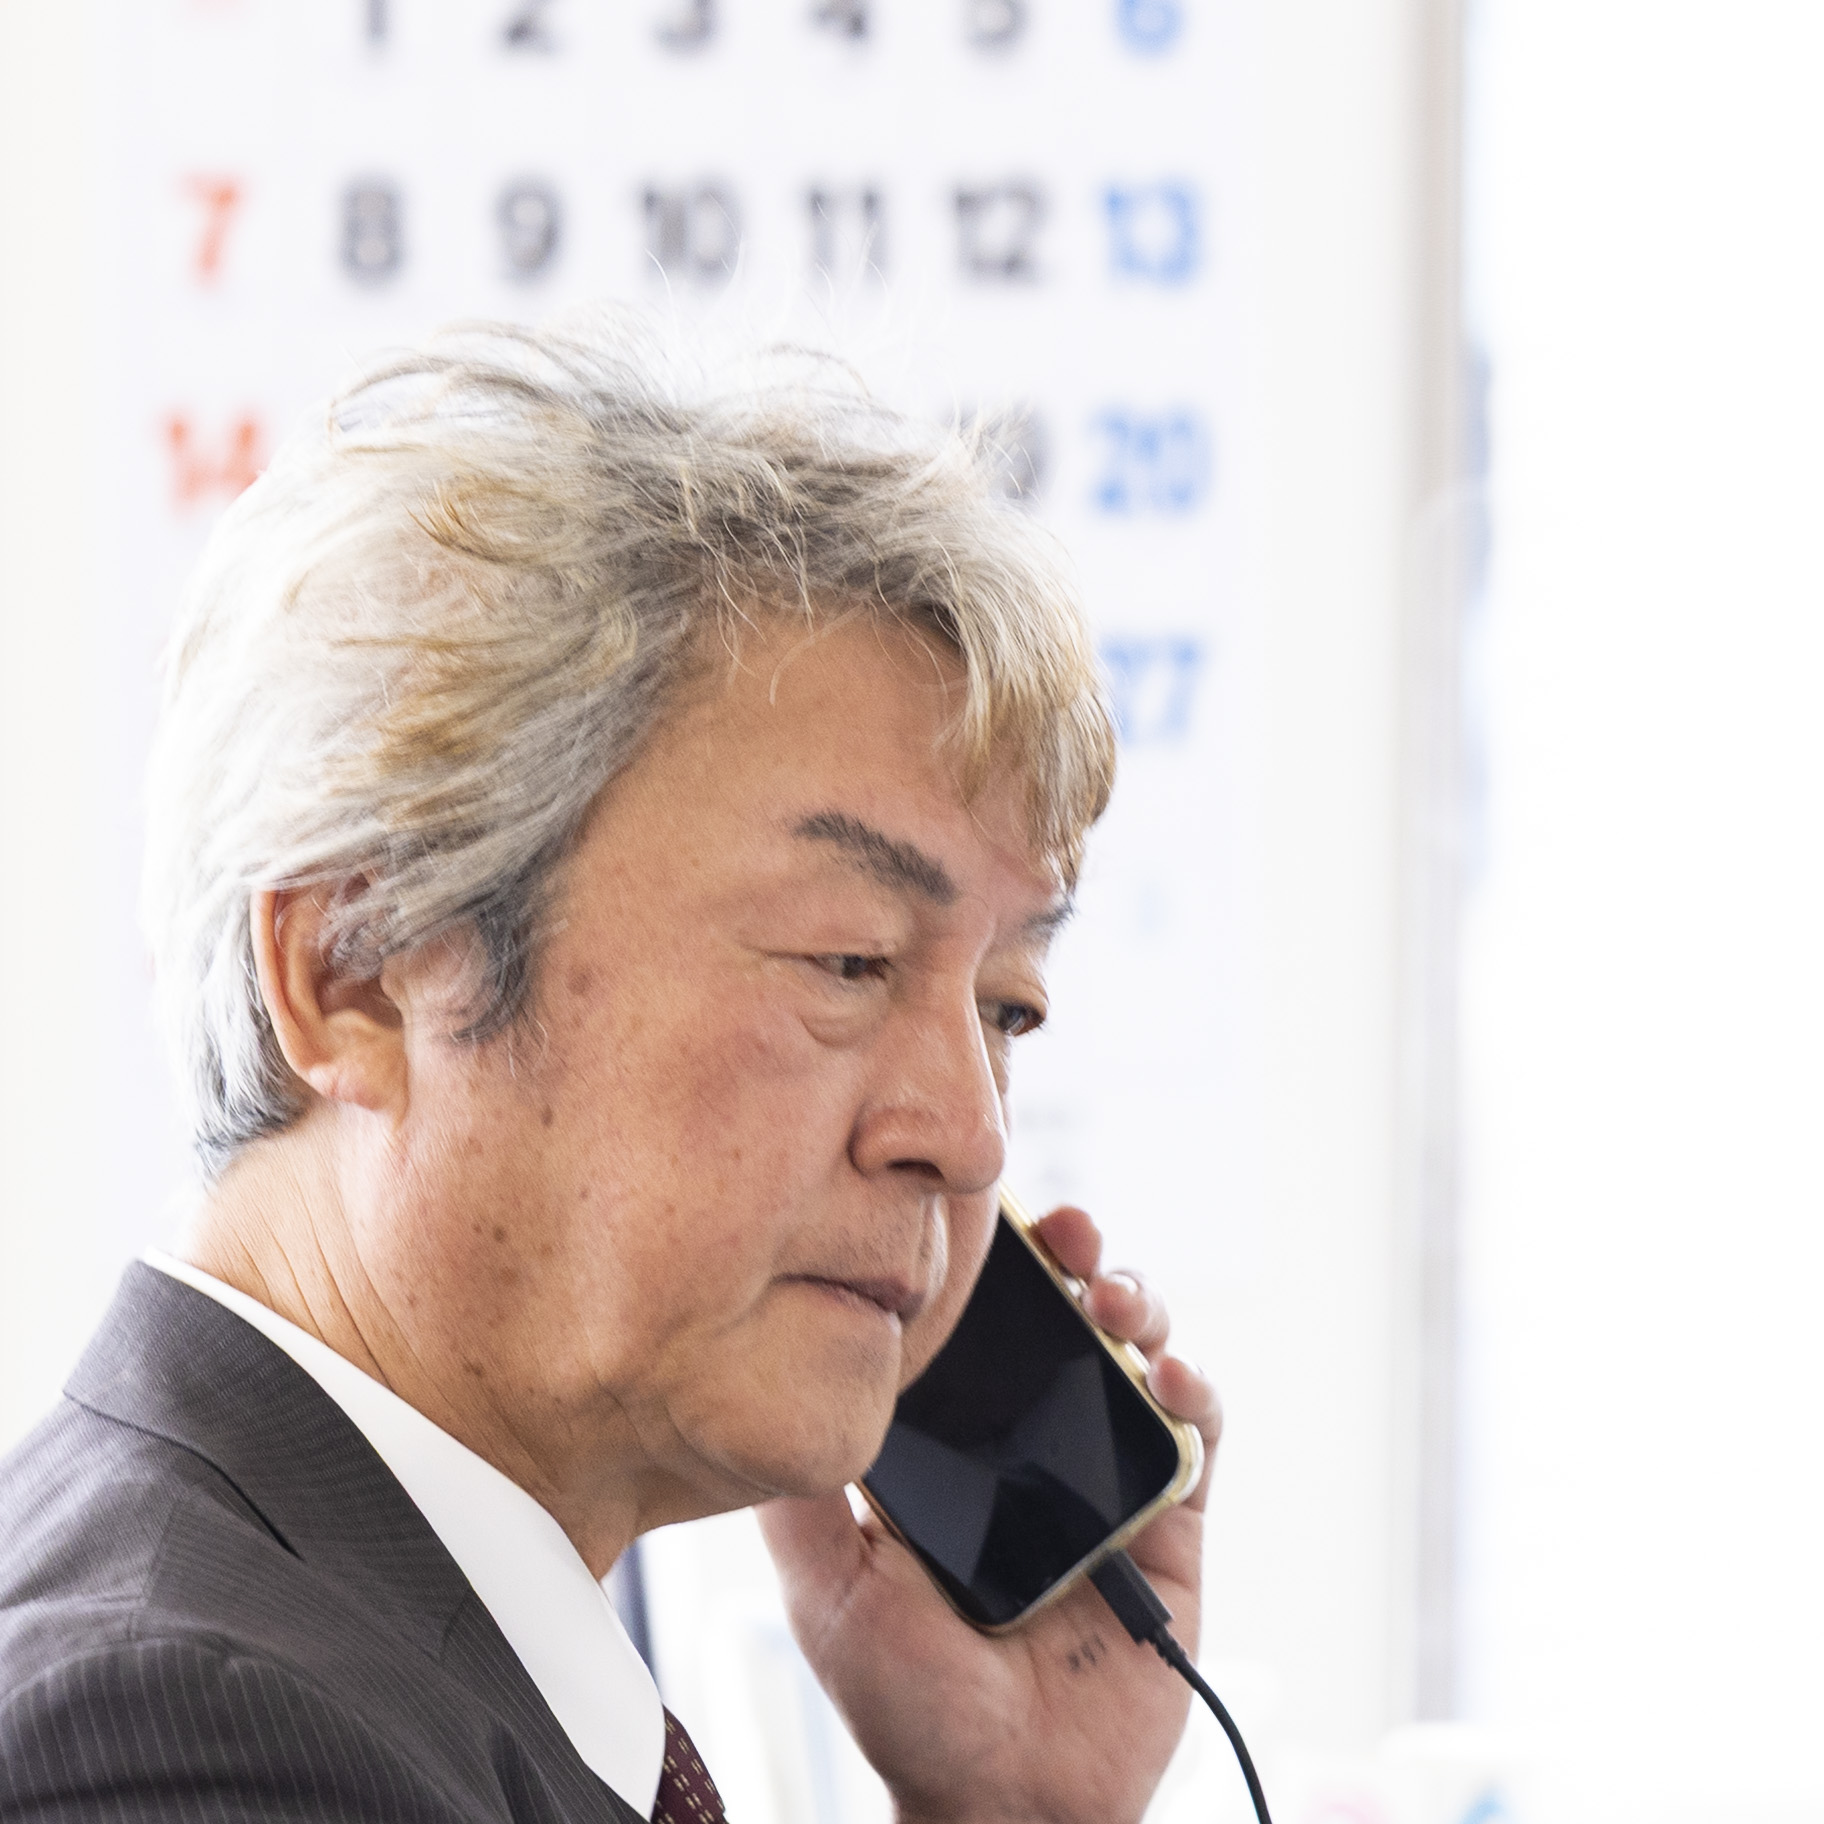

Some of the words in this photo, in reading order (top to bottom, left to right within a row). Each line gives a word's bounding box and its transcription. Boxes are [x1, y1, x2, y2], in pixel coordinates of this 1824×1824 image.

[184, 174, 244, 283] 7
[333, 171, 412, 295] 8
[491, 173, 568, 291] 9
[632, 174, 744, 289] 10
[798, 176, 890, 286] 11
[944, 174, 1052, 290] 12
[1096, 176, 1204, 290] 13
[161, 408, 268, 508] 14
[1088, 404, 1212, 518] 20
[1096, 637, 1200, 748] 27
